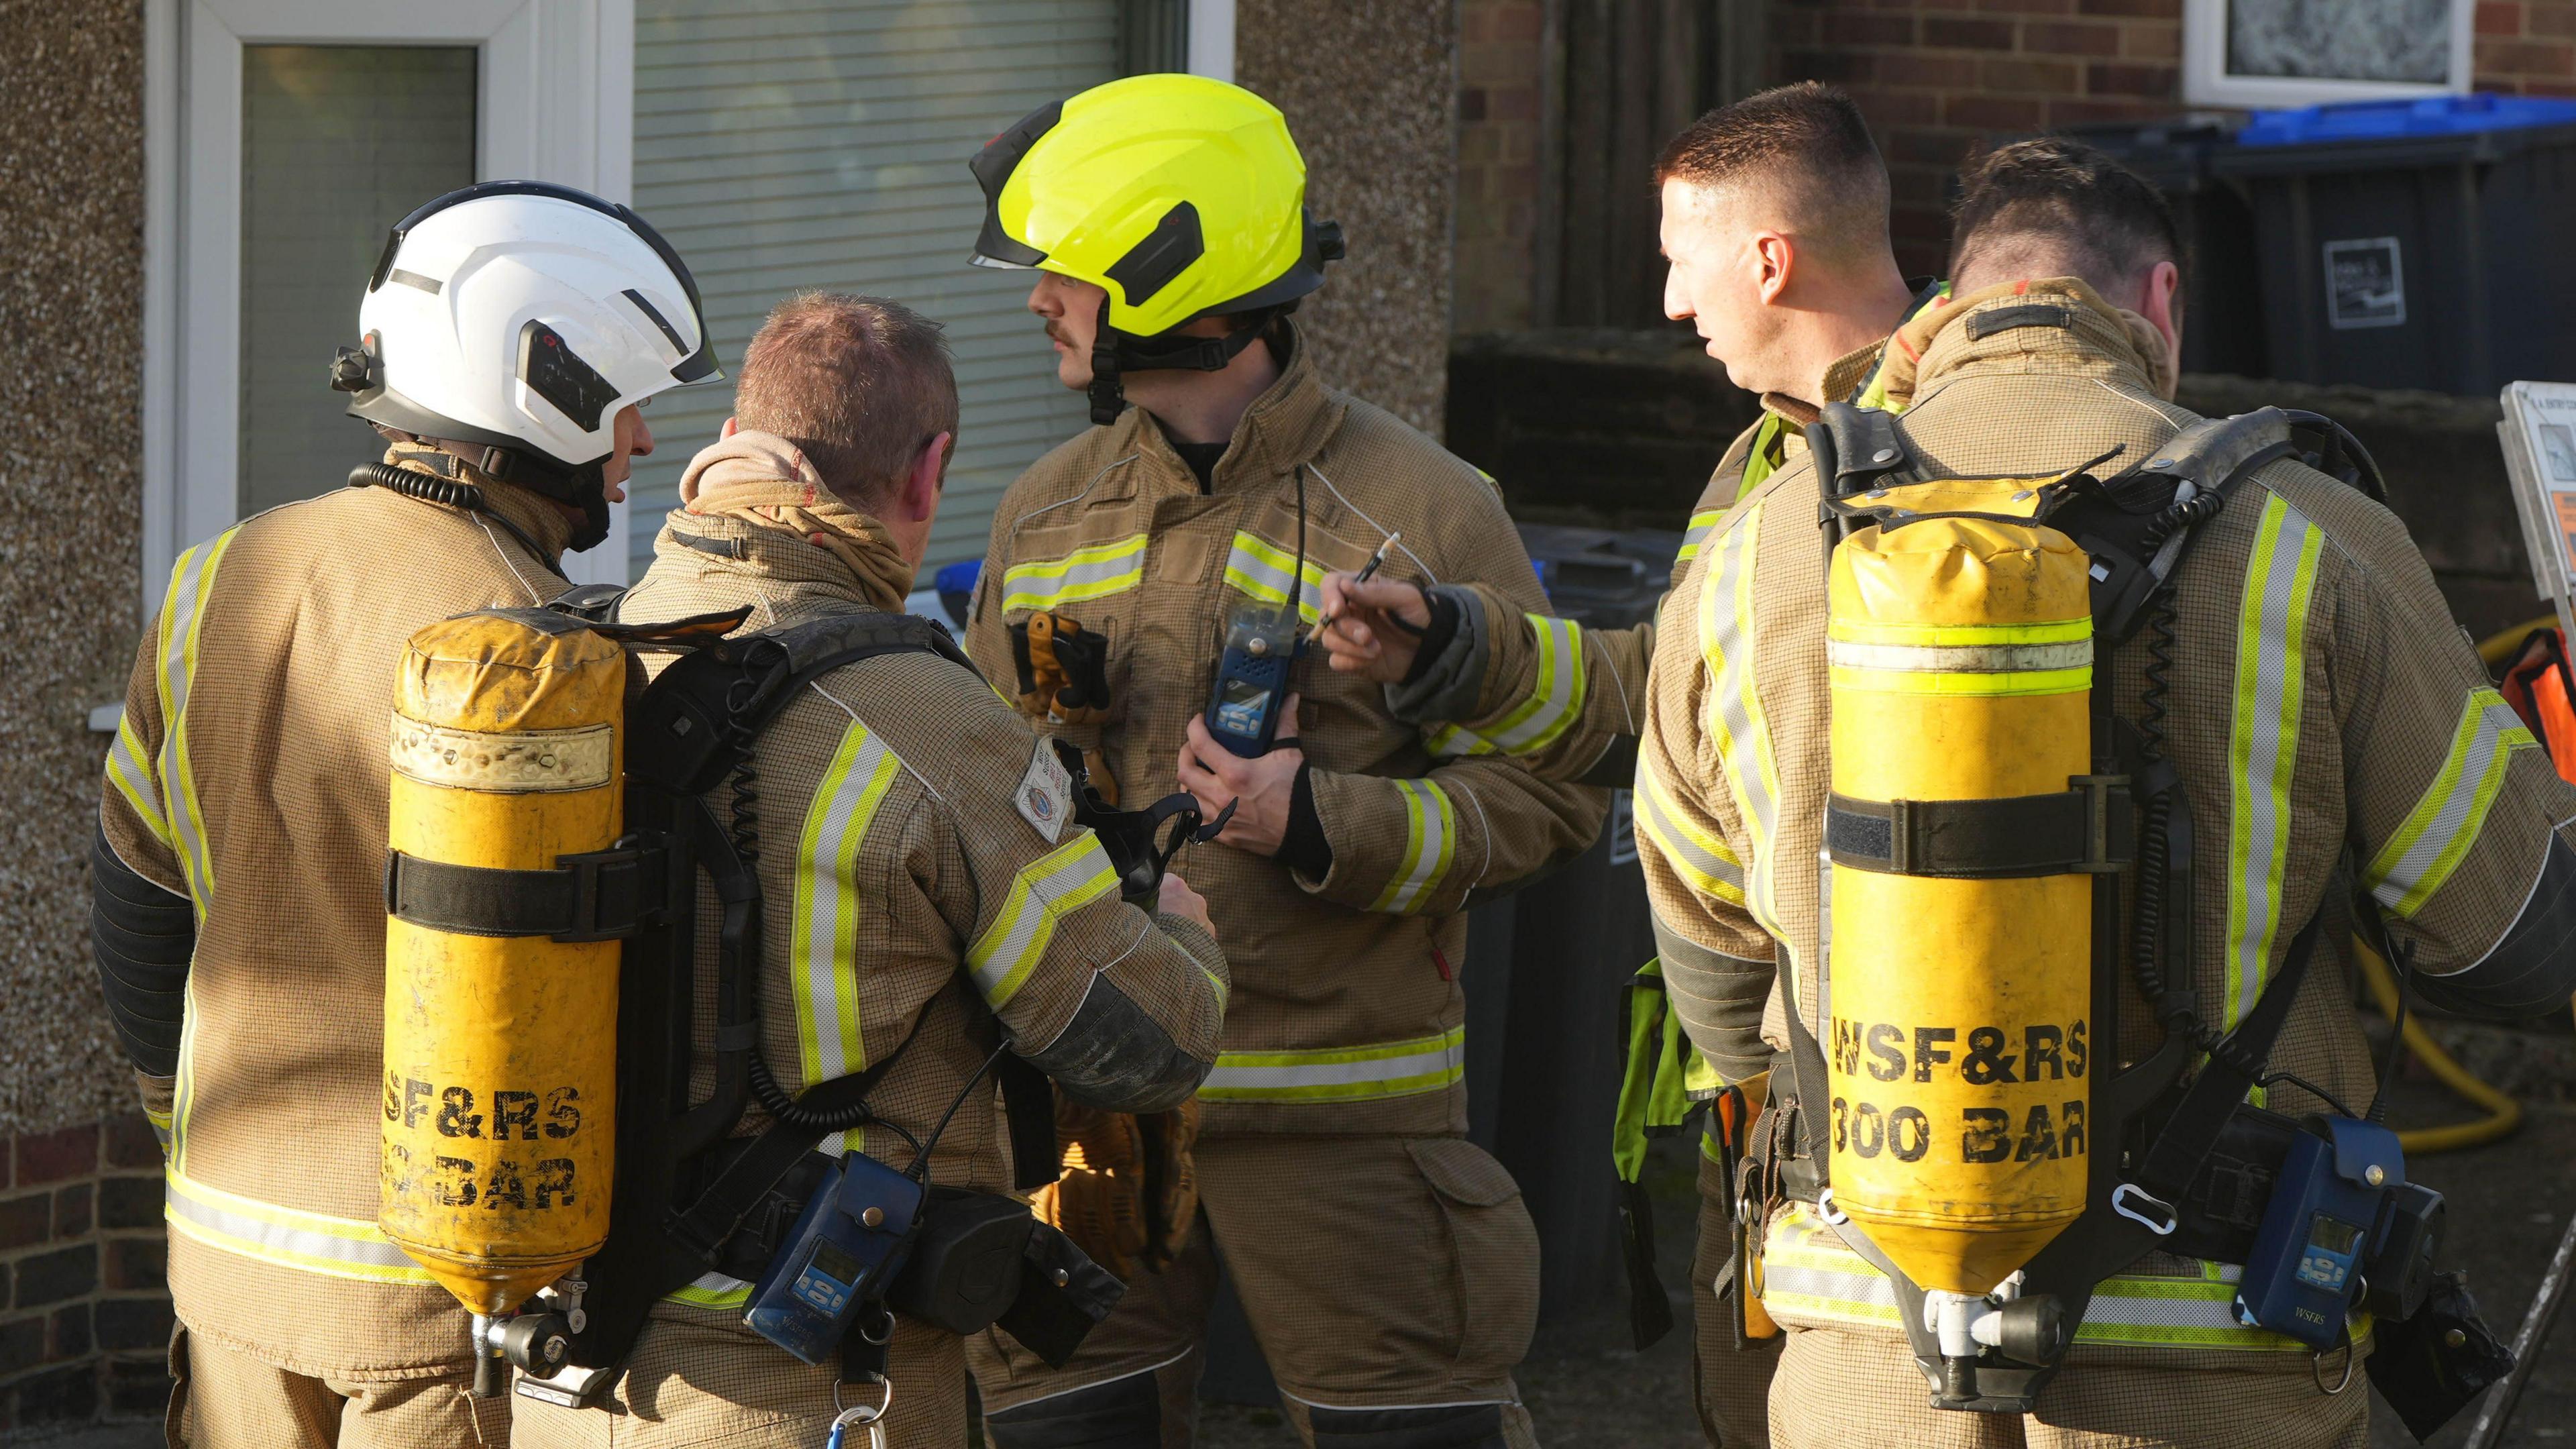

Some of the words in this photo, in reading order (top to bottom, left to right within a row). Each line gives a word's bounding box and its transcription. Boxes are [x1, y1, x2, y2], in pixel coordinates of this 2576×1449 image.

[1833, 1016, 2087, 1085] WSF&RS
[1833, 1096, 1931, 1163] 300
[1963, 1099, 2085, 1164] BAR
[2296, 1306, 2326, 1326] WSFRS
